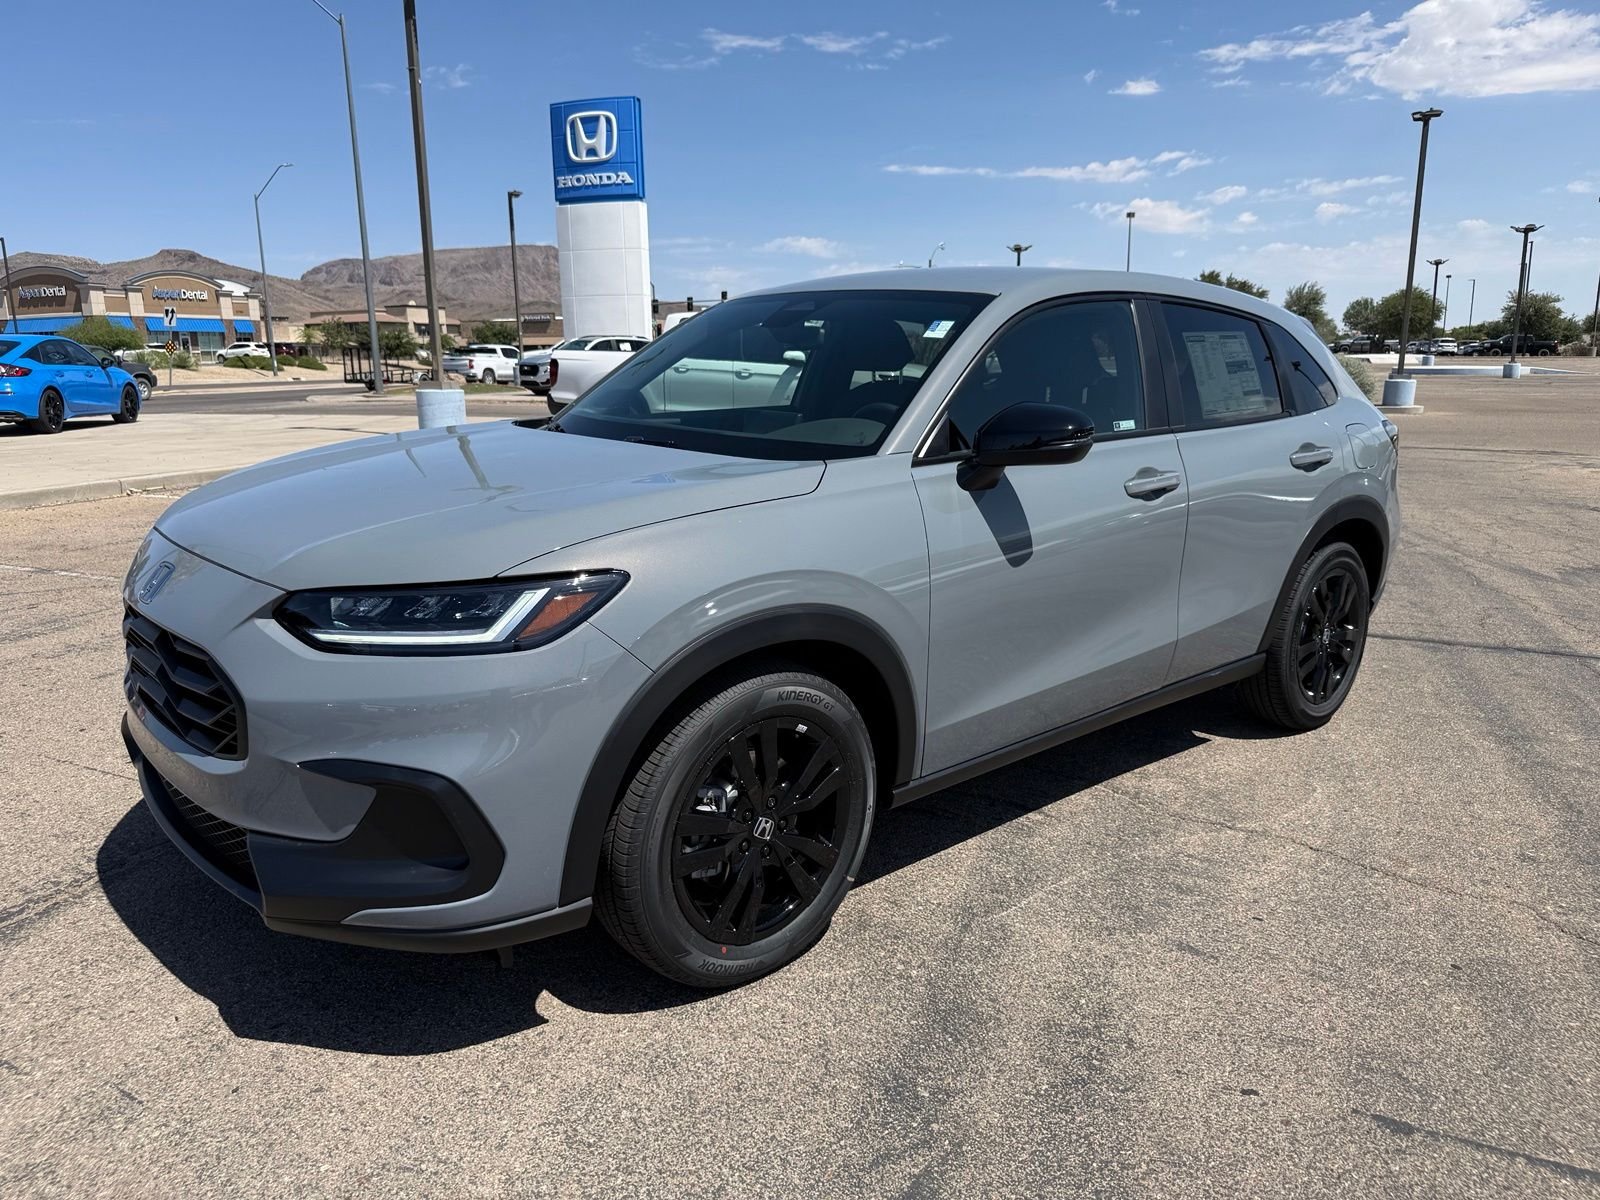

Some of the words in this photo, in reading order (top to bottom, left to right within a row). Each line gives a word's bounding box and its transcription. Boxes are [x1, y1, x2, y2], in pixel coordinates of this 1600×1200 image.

[557, 171, 634, 188] HONDA
[777, 690, 825, 704] KINERGY
[823, 702, 835, 712] GT
